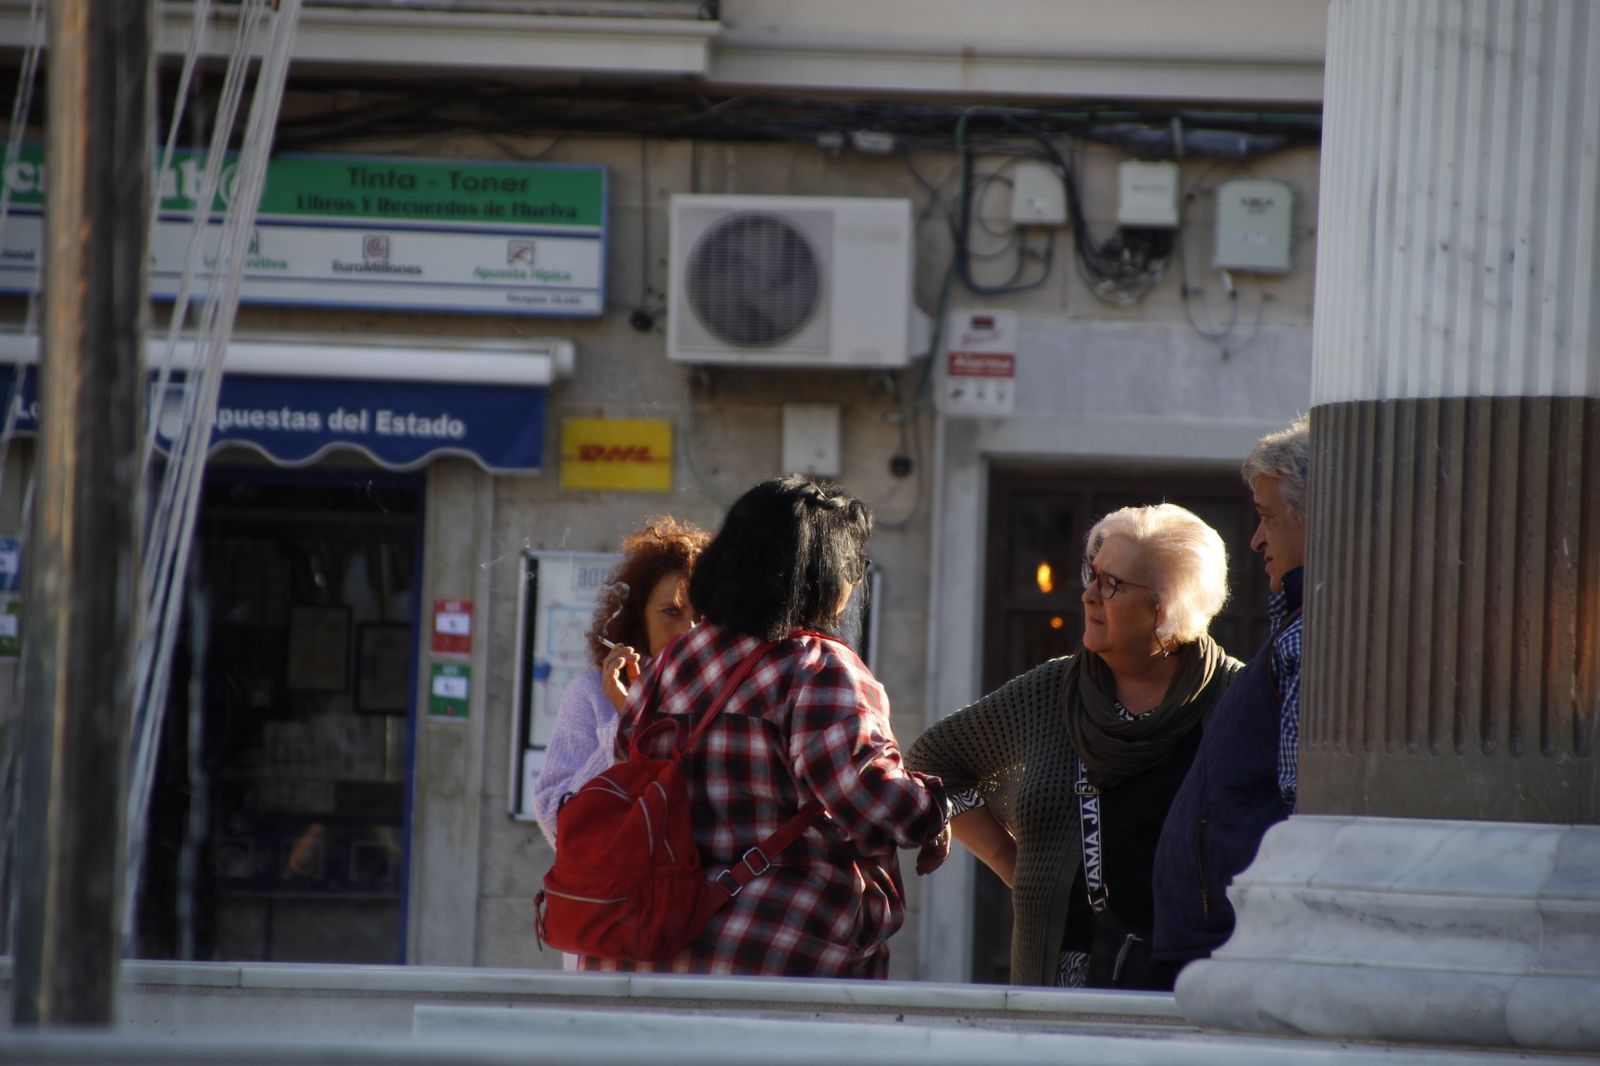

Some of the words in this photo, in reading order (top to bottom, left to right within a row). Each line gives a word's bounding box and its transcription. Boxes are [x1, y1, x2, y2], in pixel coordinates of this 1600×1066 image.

[347, 166, 416, 190] Tinta
[448, 170, 530, 193] Toner
[296, 193, 354, 212] Libros
[377, 196, 479, 216] Recuerdos
[483, 200, 505, 215] de
[511, 202, 577, 219] Huelva
[332, 260, 423, 276] EuroMillones
[213, 407, 320, 432] puestas
[327, 408, 367, 432] del
[375, 410, 466, 438] Estado
